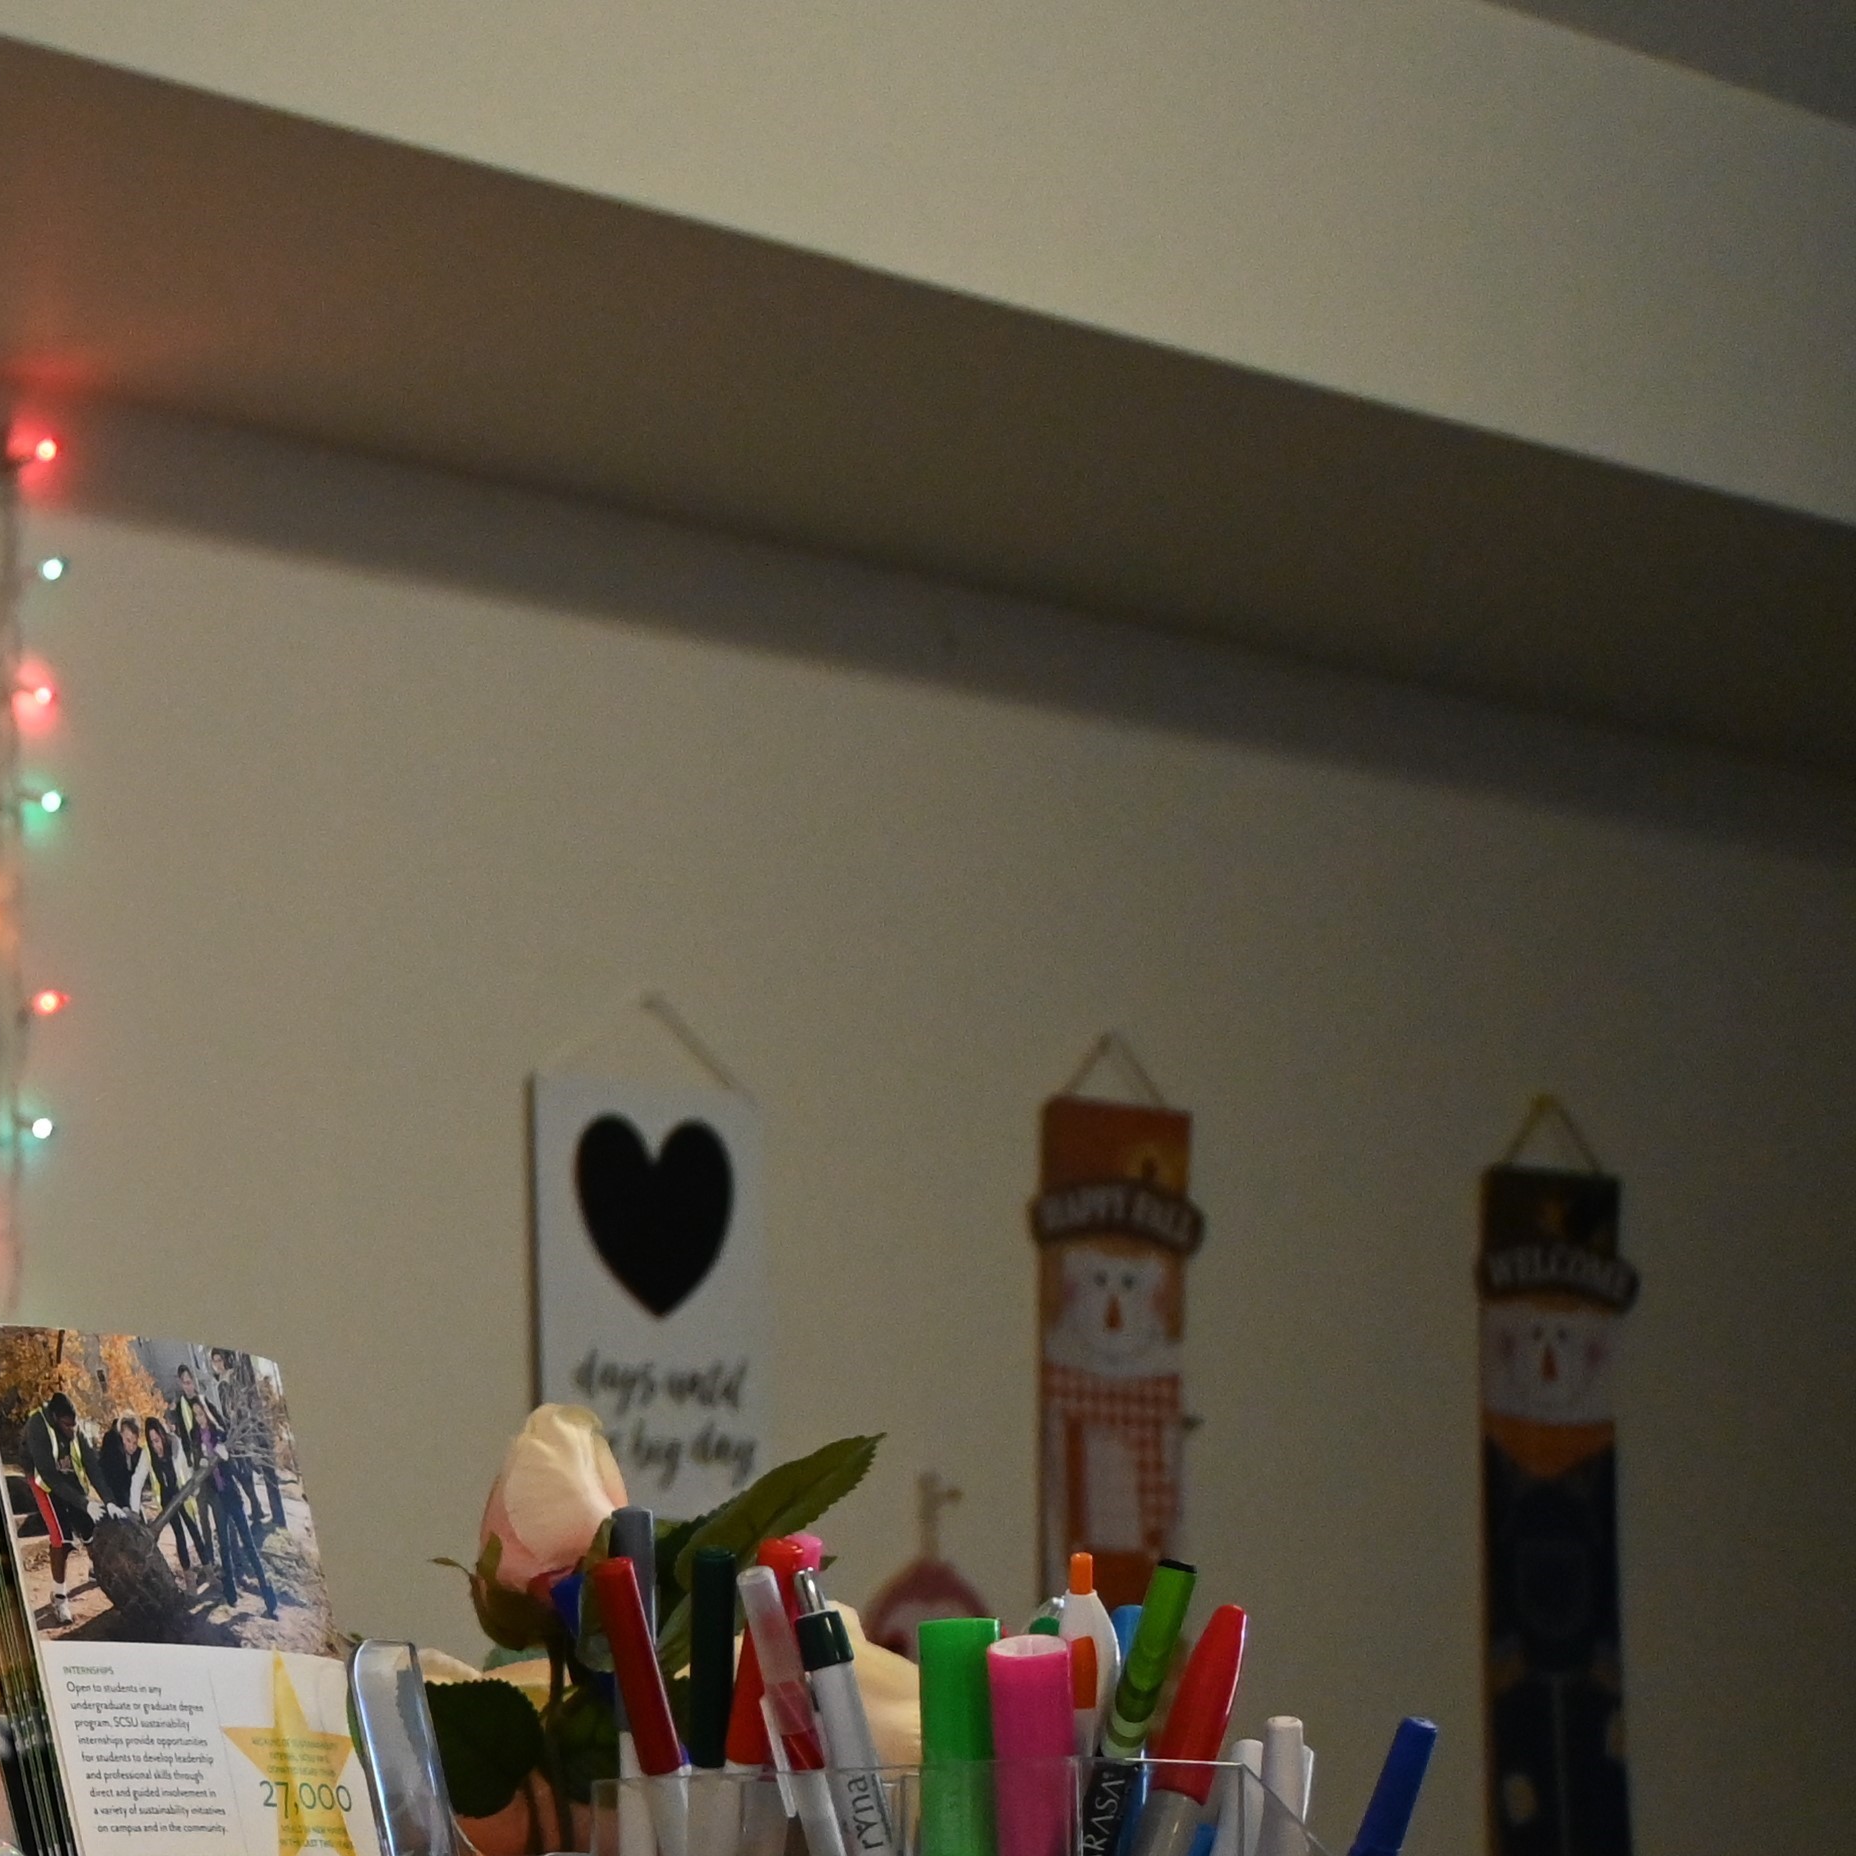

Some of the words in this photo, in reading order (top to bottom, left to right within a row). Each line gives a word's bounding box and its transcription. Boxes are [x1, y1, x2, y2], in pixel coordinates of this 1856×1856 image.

[1490, 1244, 1633, 1298] WELCOME
[63, 1666, 114, 1675] INTERNSHIPS
[66, 1681, 91, 1696] Open
[93, 1684, 101, 1692] to
[104, 1683, 137, 1693] students
[148, 1687, 162, 1697] any
[71, 1700, 131, 1713] undergraduate
[143, 1701, 177, 1715] graduate
[179, 1703, 204, 1715] degree
[75, 1718, 112, 1731] program,
[113, 1716, 138, 1727] SCSU
[141, 1718, 190, 1732] sustainability
[78, 1735, 124, 1748] internships
[126, 1736, 155, 1748] provide
[157, 1738, 208, 1748] opportunities
[82, 1752, 94, 1762] for
[96, 1752, 131, 1762] students
[133, 1754, 141, 1762] to
[143, 1754, 173, 1766] develop
[175, 1753, 214, 1766] leadership
[86, 1772, 102, 1780] and
[104, 1770, 152, 1783] professional
[154, 1771, 171, 1780] skills
[174, 1772, 204, 1785] through
[90, 1788, 113, 1797] direct
[116, 1789, 131, 1797] and
[133, 1789, 160, 1801] guided
[162, 1788, 207, 1798] involvement
[209, 1790, 216, 1798] in
[259, 1780, 352, 1819] 27,000
[100, 1807, 127, 1818] variety
[129, 1804, 137, 1814] of
[139, 1807, 189, 1818] sustainability
[191, 1807, 226, 1816] initiatives
[111, 1825, 142, 1836] campus
[144, 1823, 158, 1832] and
[160, 1824, 167, 1832] in
[169, 1823, 181, 1832] the
[183, 1825, 228, 1835] community.
